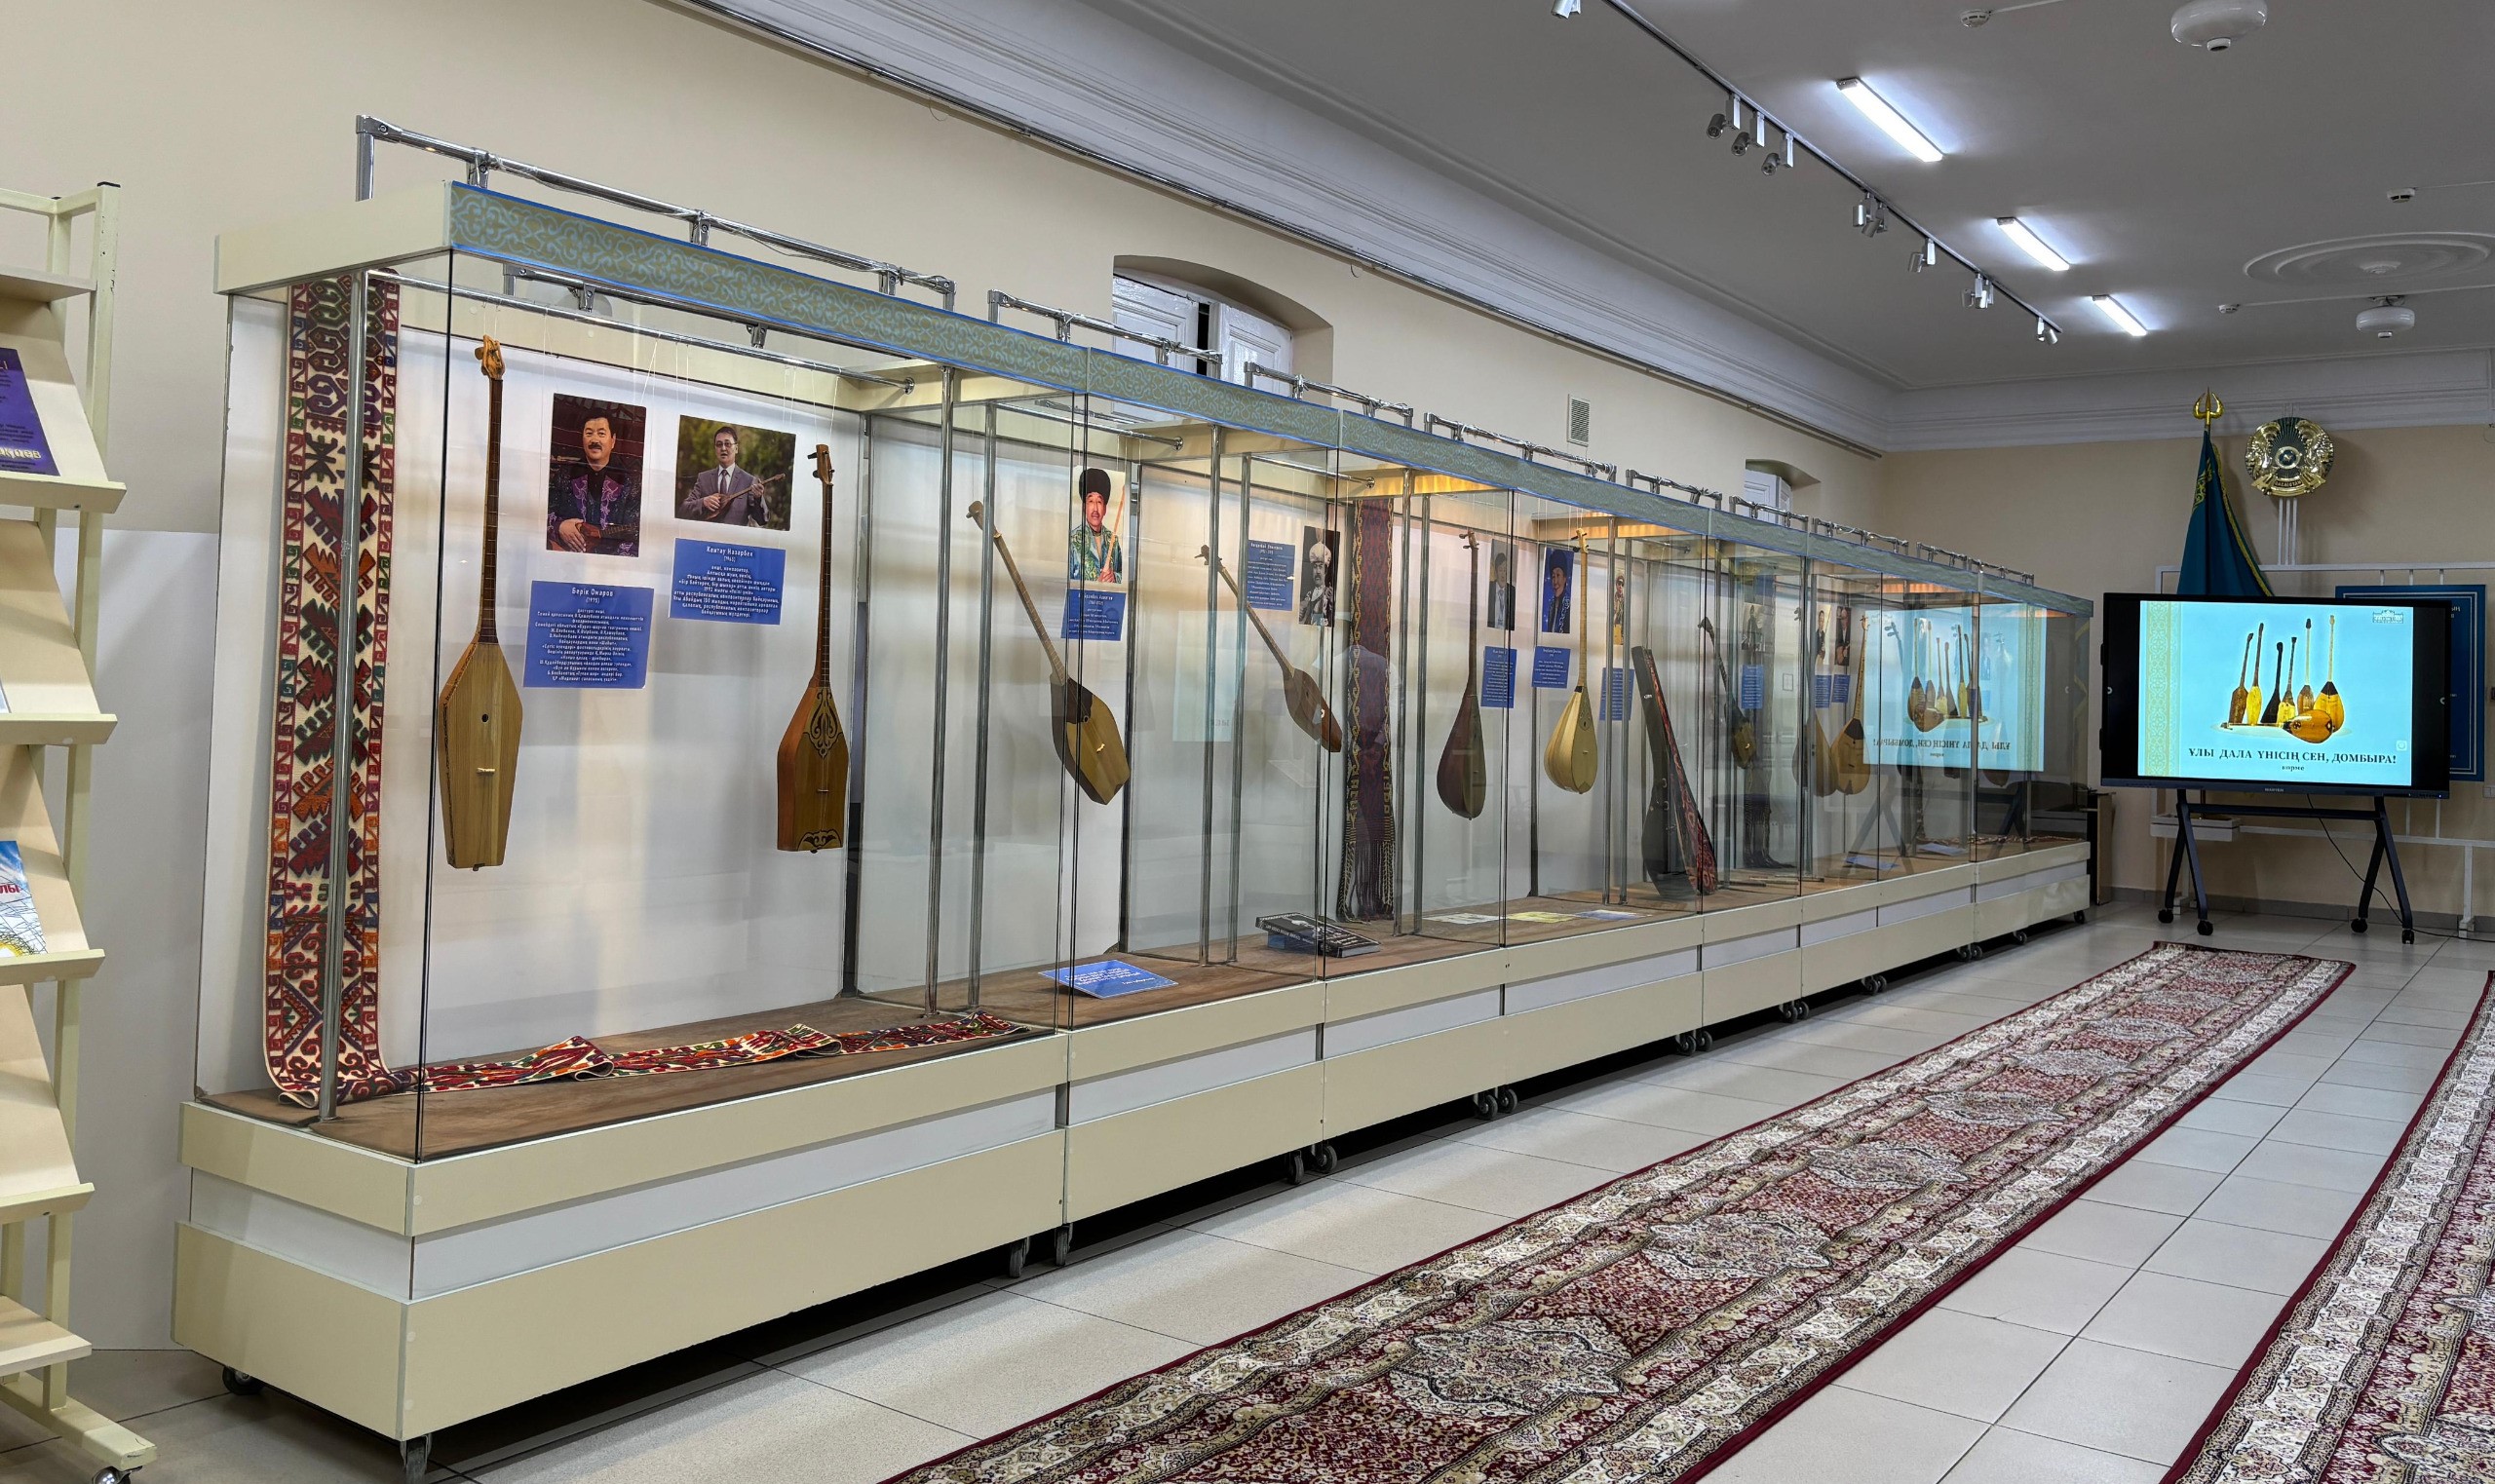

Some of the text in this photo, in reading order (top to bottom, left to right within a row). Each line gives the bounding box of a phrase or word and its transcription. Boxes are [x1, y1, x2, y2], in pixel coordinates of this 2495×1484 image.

[572, 588, 613, 597] Берік Омаров
[2188, 747, 2397, 764] ҰЛЫ ДАЛА ҮНІСІҢ СЕН, ДОМБЫРА!
